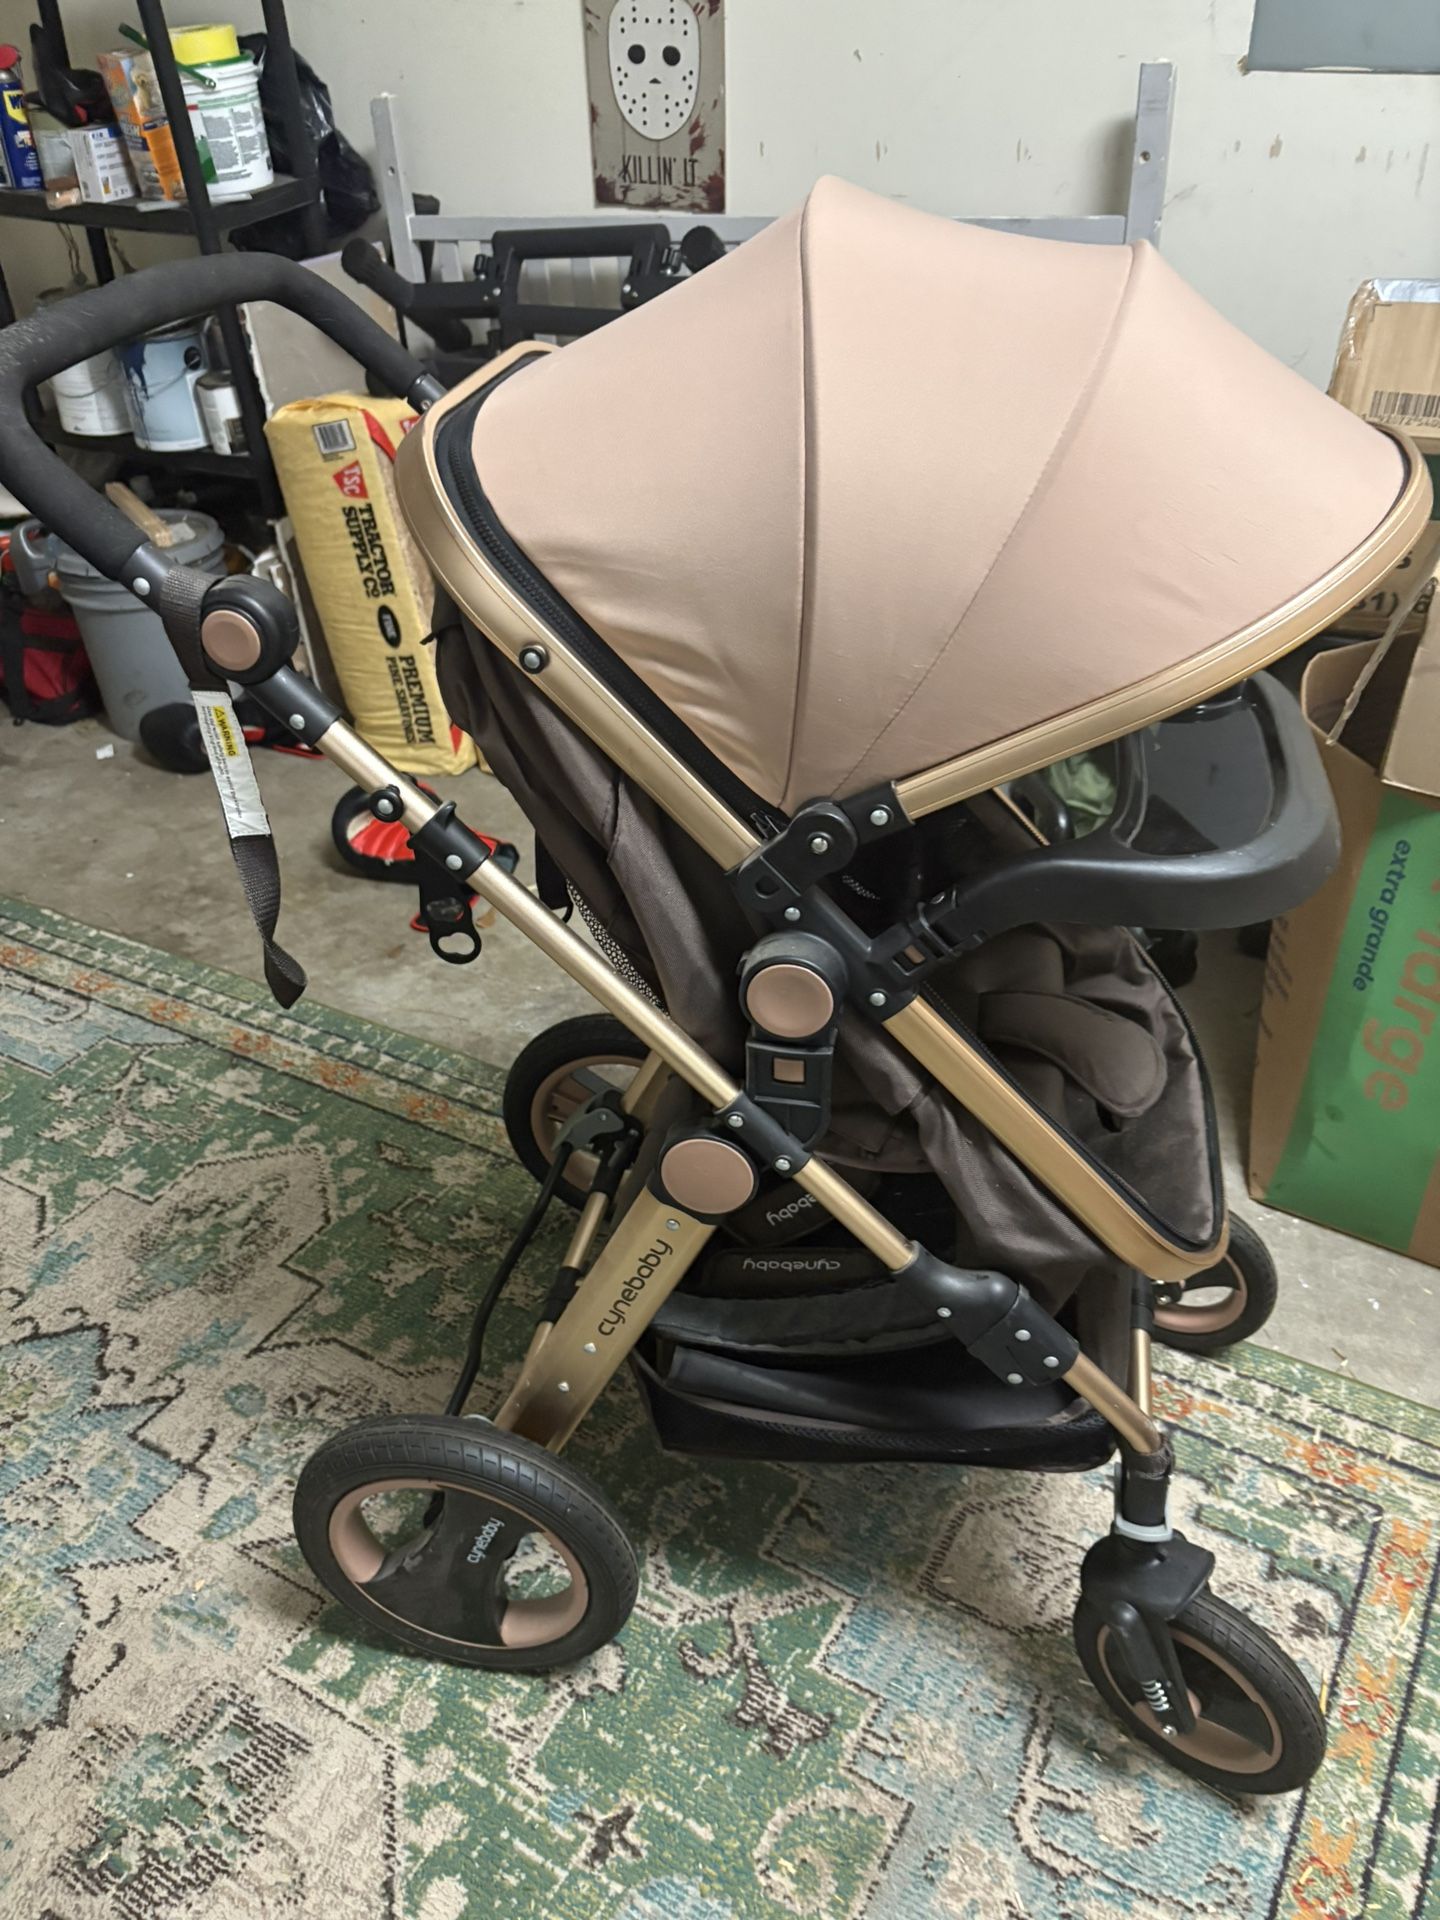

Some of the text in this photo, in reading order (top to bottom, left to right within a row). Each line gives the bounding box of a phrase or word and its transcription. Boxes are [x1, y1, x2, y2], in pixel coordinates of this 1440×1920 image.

[619, 155, 699, 187] KILLIN' IT
[342, 464, 362, 496] TSC
[342, 505, 375, 575] SUPPLY
[359, 502, 396, 597] TRACTOR
[385, 656, 416, 744] PINE SHAVINGS
[399, 655, 436, 745] PREMIUM
[217, 718, 236, 757] WARNING
[1353, 839, 1411, 991] extra grande
[766, 1194, 816, 1226] ebaby
[597, 1238, 673, 1336] cynebaby
[742, 1258, 840, 1272] cynebaby
[467, 1517, 505, 1564] cynebaby
